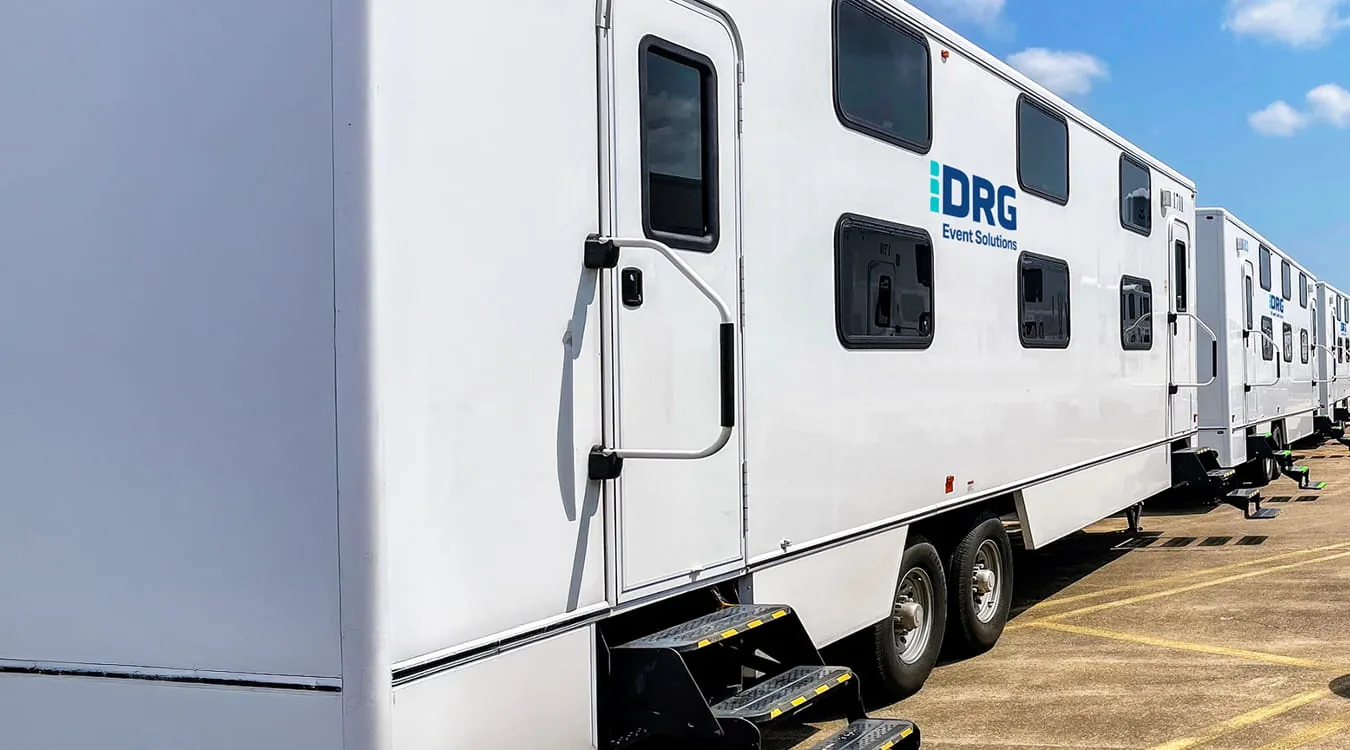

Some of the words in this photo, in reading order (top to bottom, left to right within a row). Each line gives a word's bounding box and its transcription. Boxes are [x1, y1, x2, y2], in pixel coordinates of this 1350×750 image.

[942, 163, 1017, 231] DRG
[942, 222, 974, 244] Event
[975, 229, 1018, 251] Solutions
[1270, 294, 1284, 313] DRG
